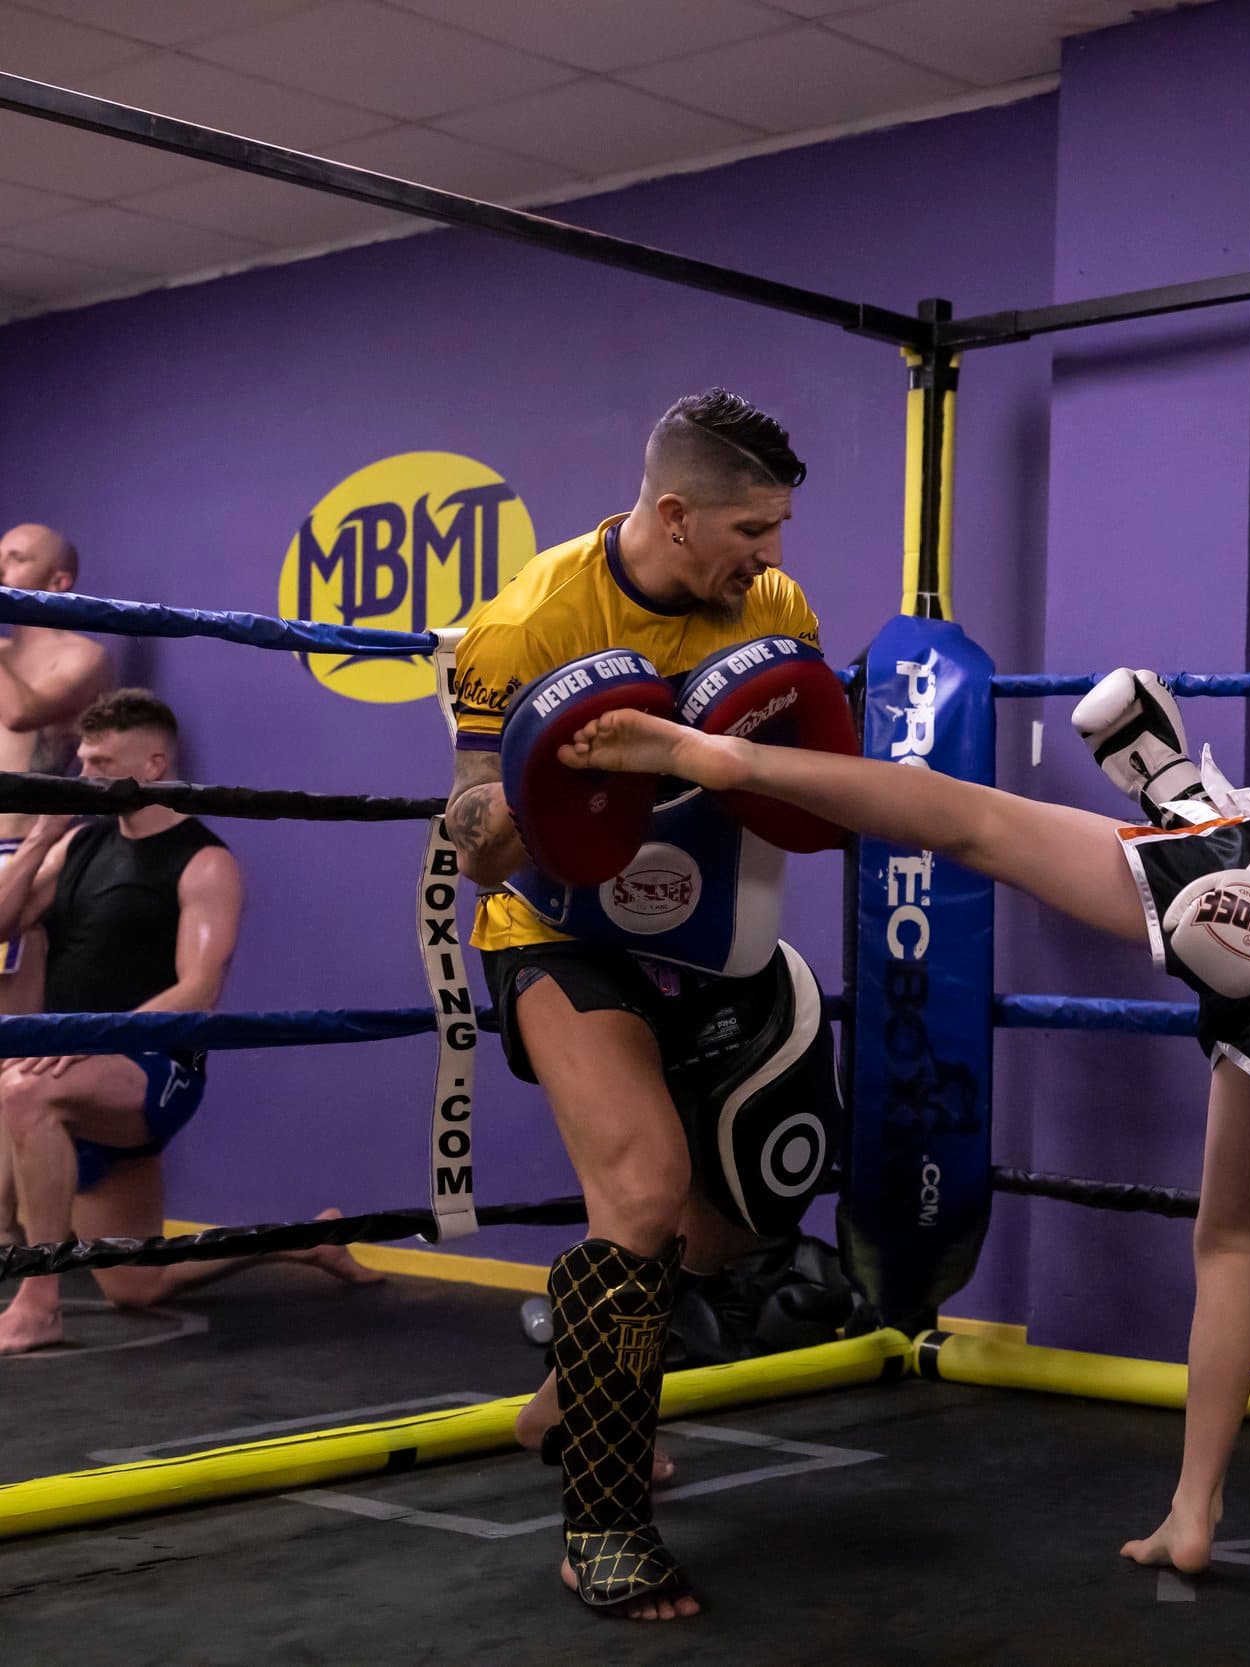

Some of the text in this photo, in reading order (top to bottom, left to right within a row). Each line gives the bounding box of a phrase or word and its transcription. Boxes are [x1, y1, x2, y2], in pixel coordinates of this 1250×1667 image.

[298, 483, 517, 640] MBMT
[532, 669, 594, 718] NEVER
[595, 656, 639, 679] GIVE
[681, 639, 798, 725] NEVER GIVE UP
[425, 850, 477, 1050] BOXING
[437, 1078, 473, 1196] .COM
